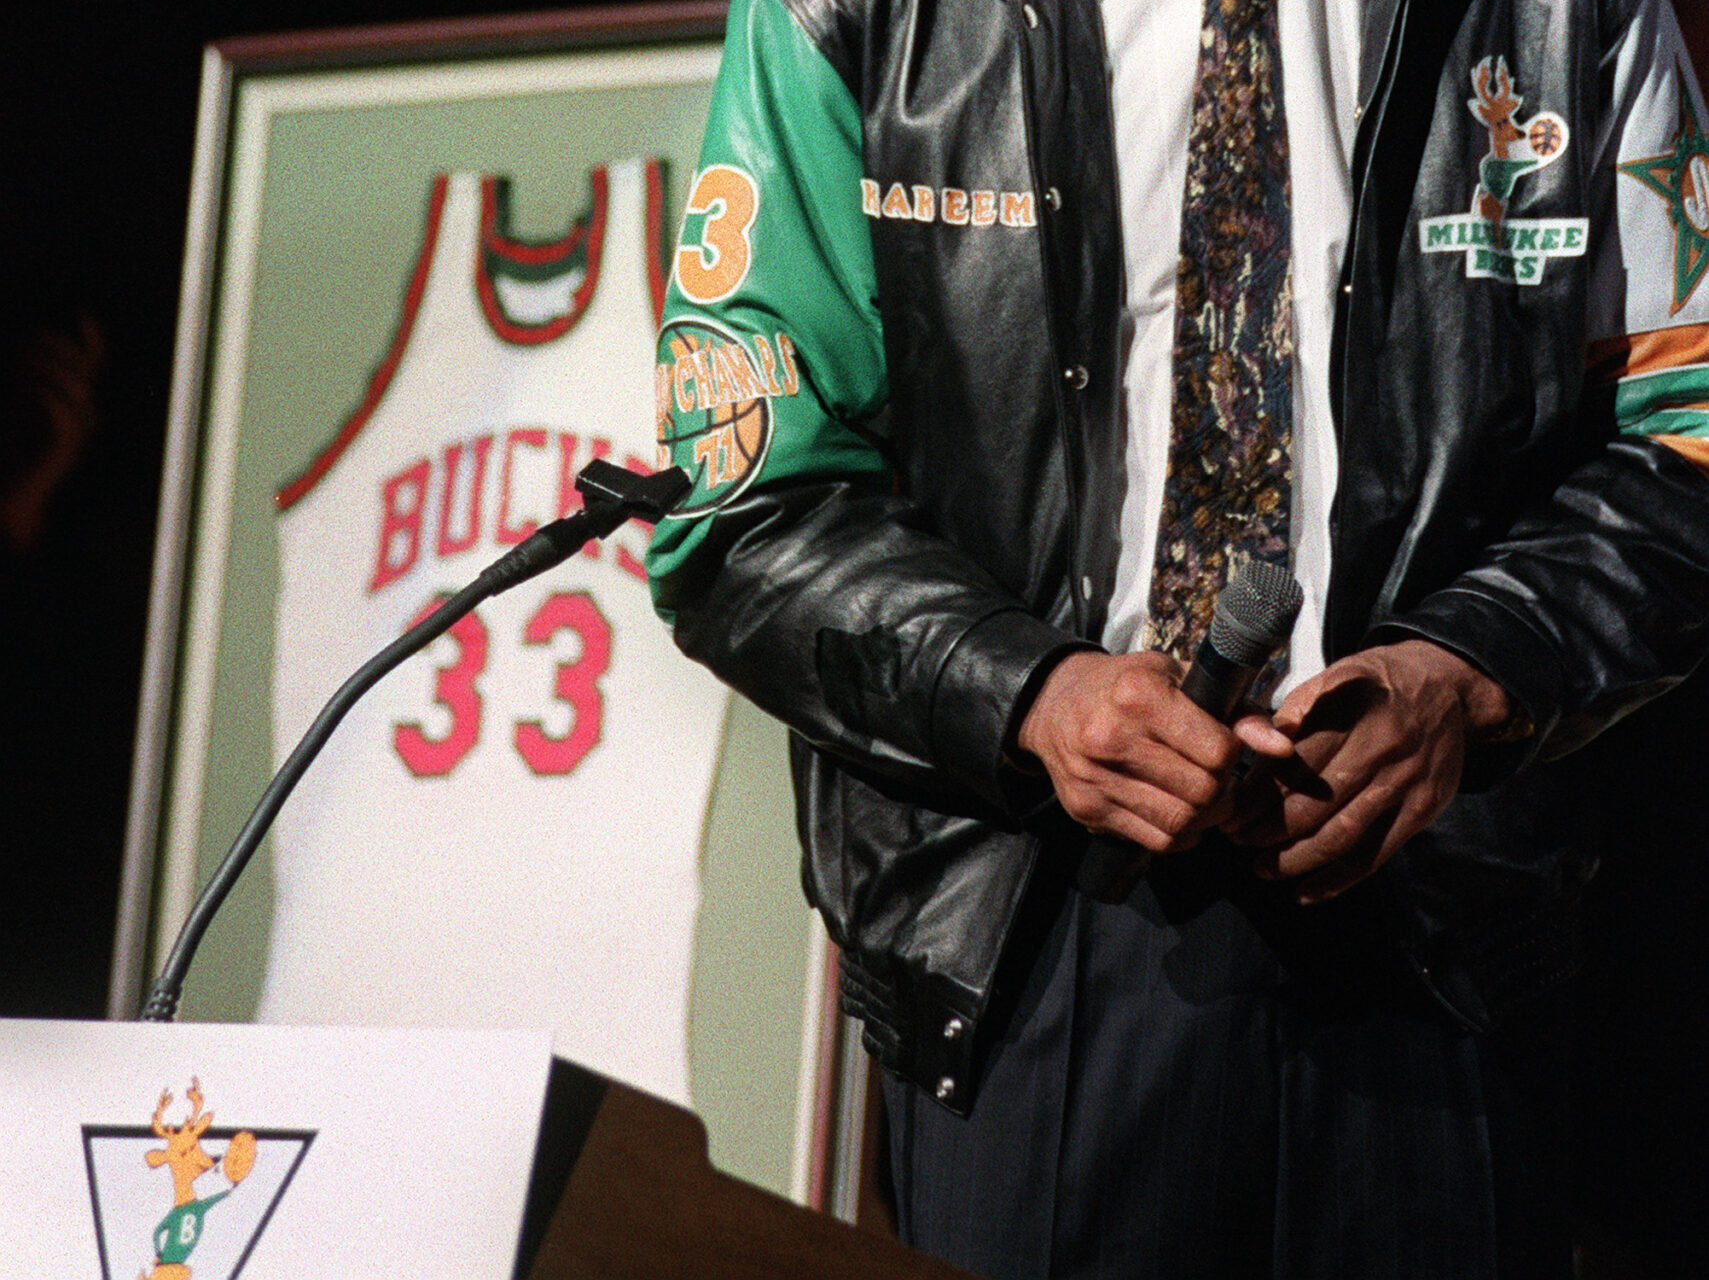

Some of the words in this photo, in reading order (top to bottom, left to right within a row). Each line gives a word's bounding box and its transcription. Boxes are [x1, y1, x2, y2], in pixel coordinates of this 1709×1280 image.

[674, 164, 760, 305] 3
[860, 178, 1038, 227] KAREEM
[391, 589, 614, 777] 33
